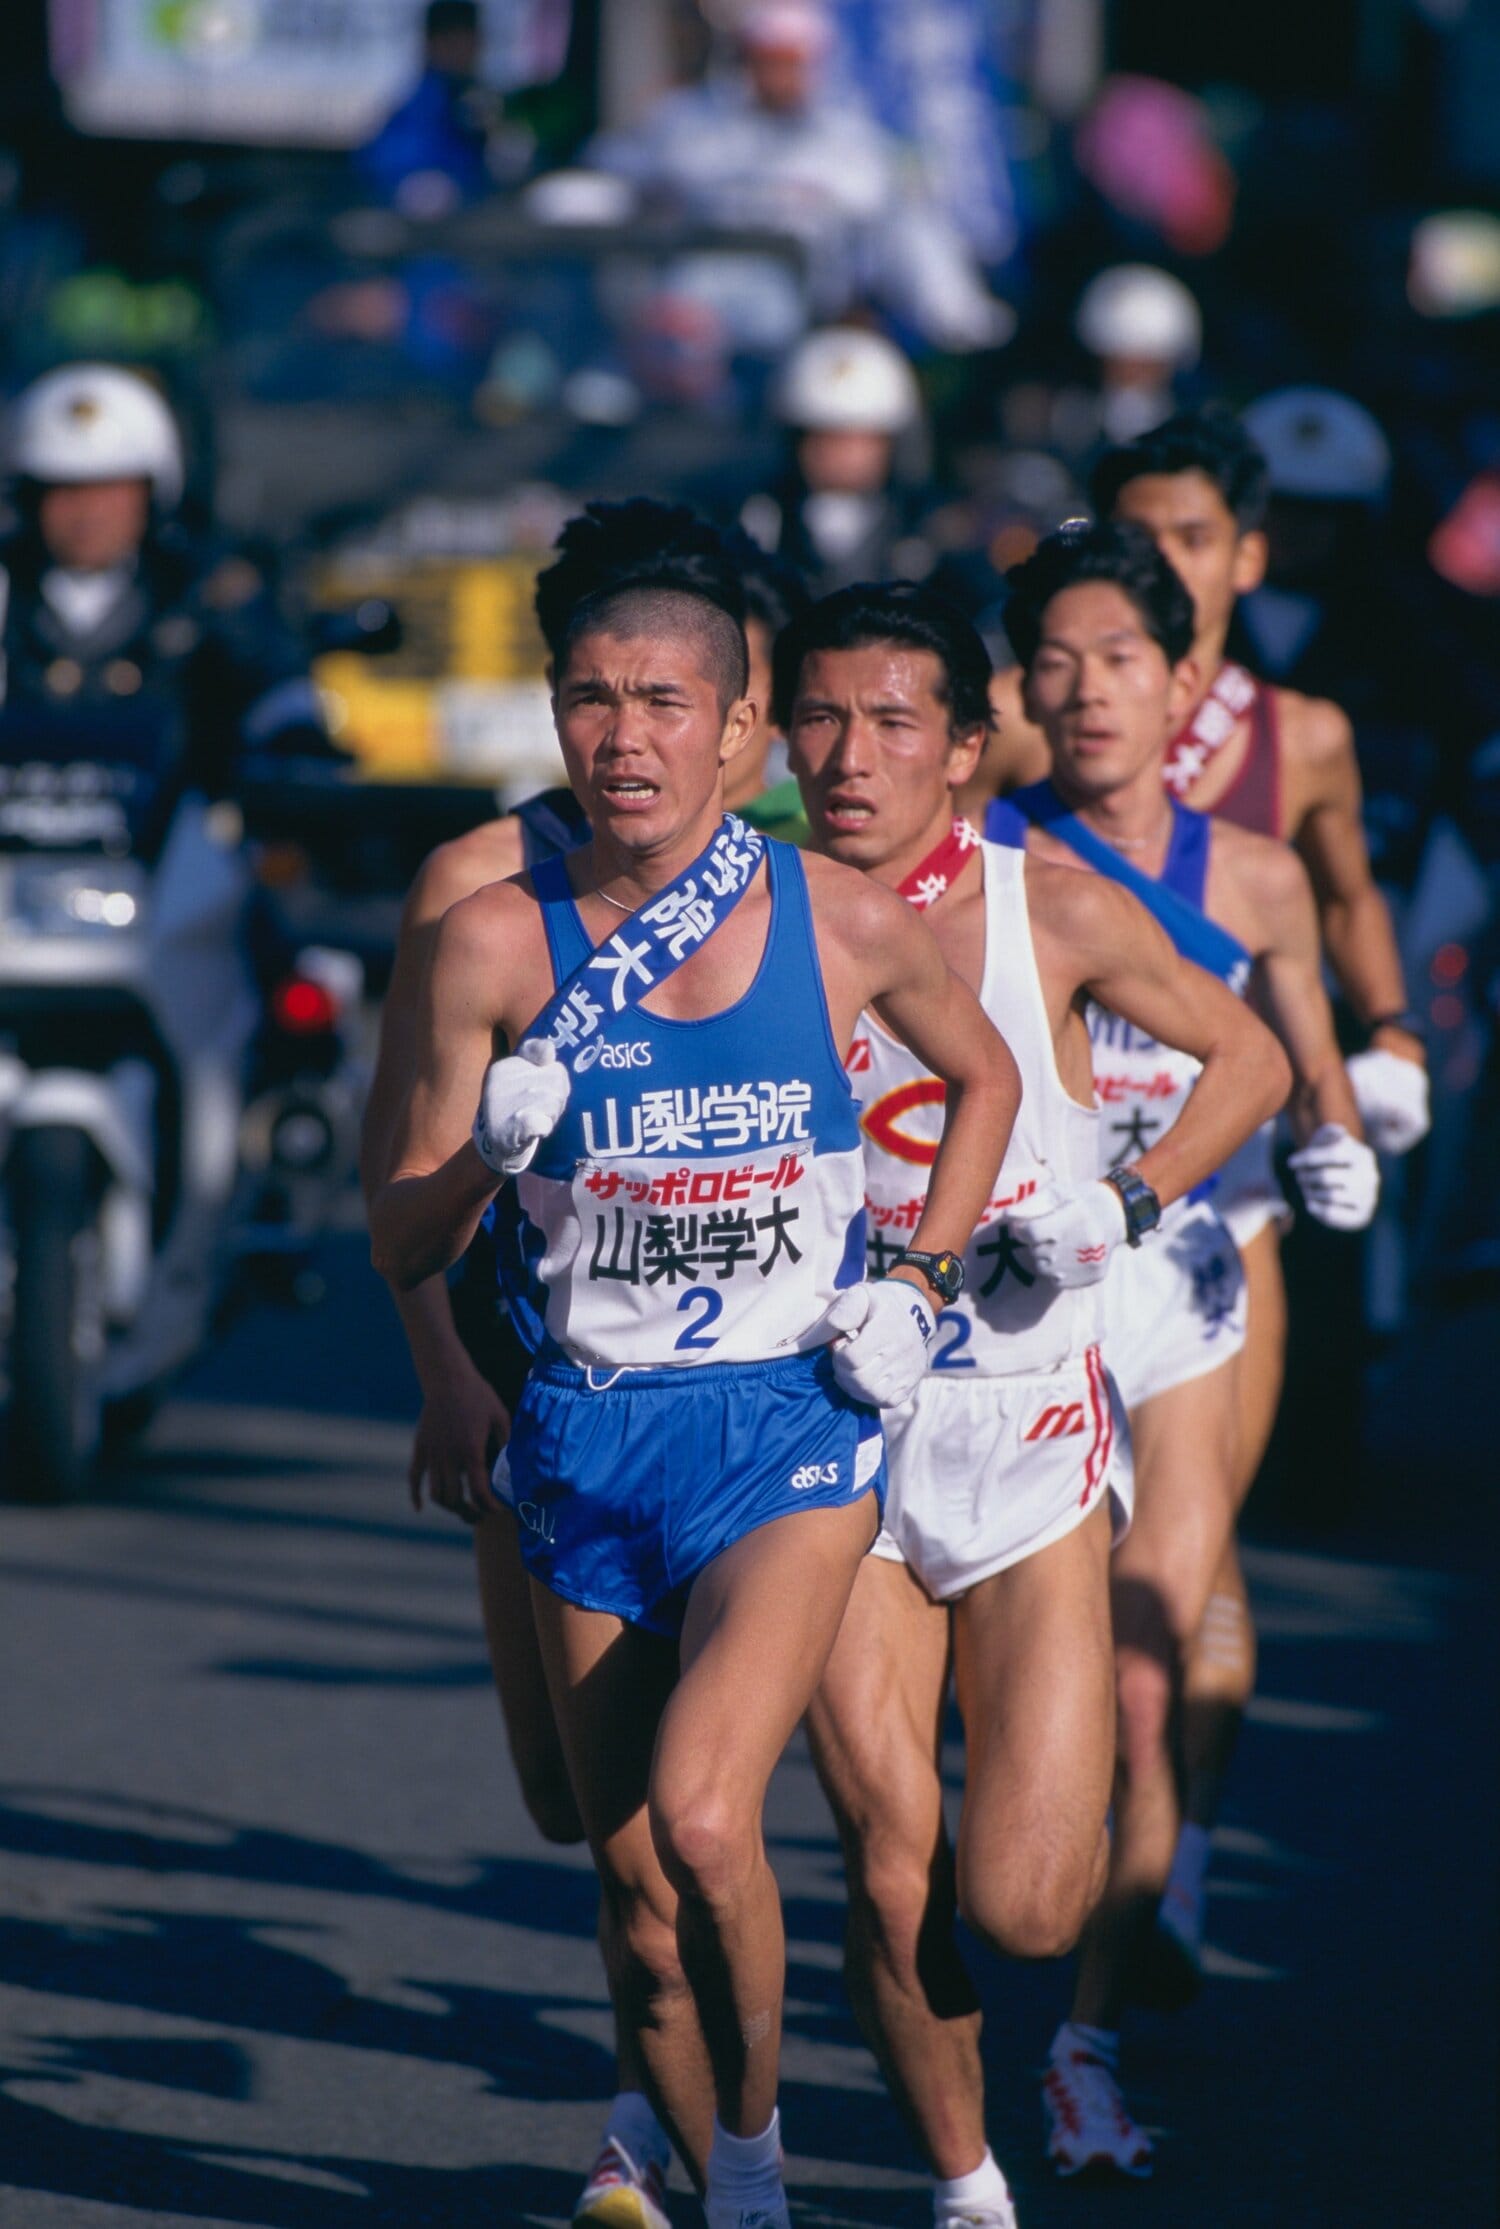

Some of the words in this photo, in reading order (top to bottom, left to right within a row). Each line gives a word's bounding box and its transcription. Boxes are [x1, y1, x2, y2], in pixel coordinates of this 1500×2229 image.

[601, 1041, 652, 1069] asics
[582, 1079, 812, 1159] 山梨学院
[584, 1153, 805, 1206] サッポロビール
[588, 1195, 803, 1286] 山梨学大
[674, 1286, 723, 1350] 2
[931, 1311, 976, 1369] 2
